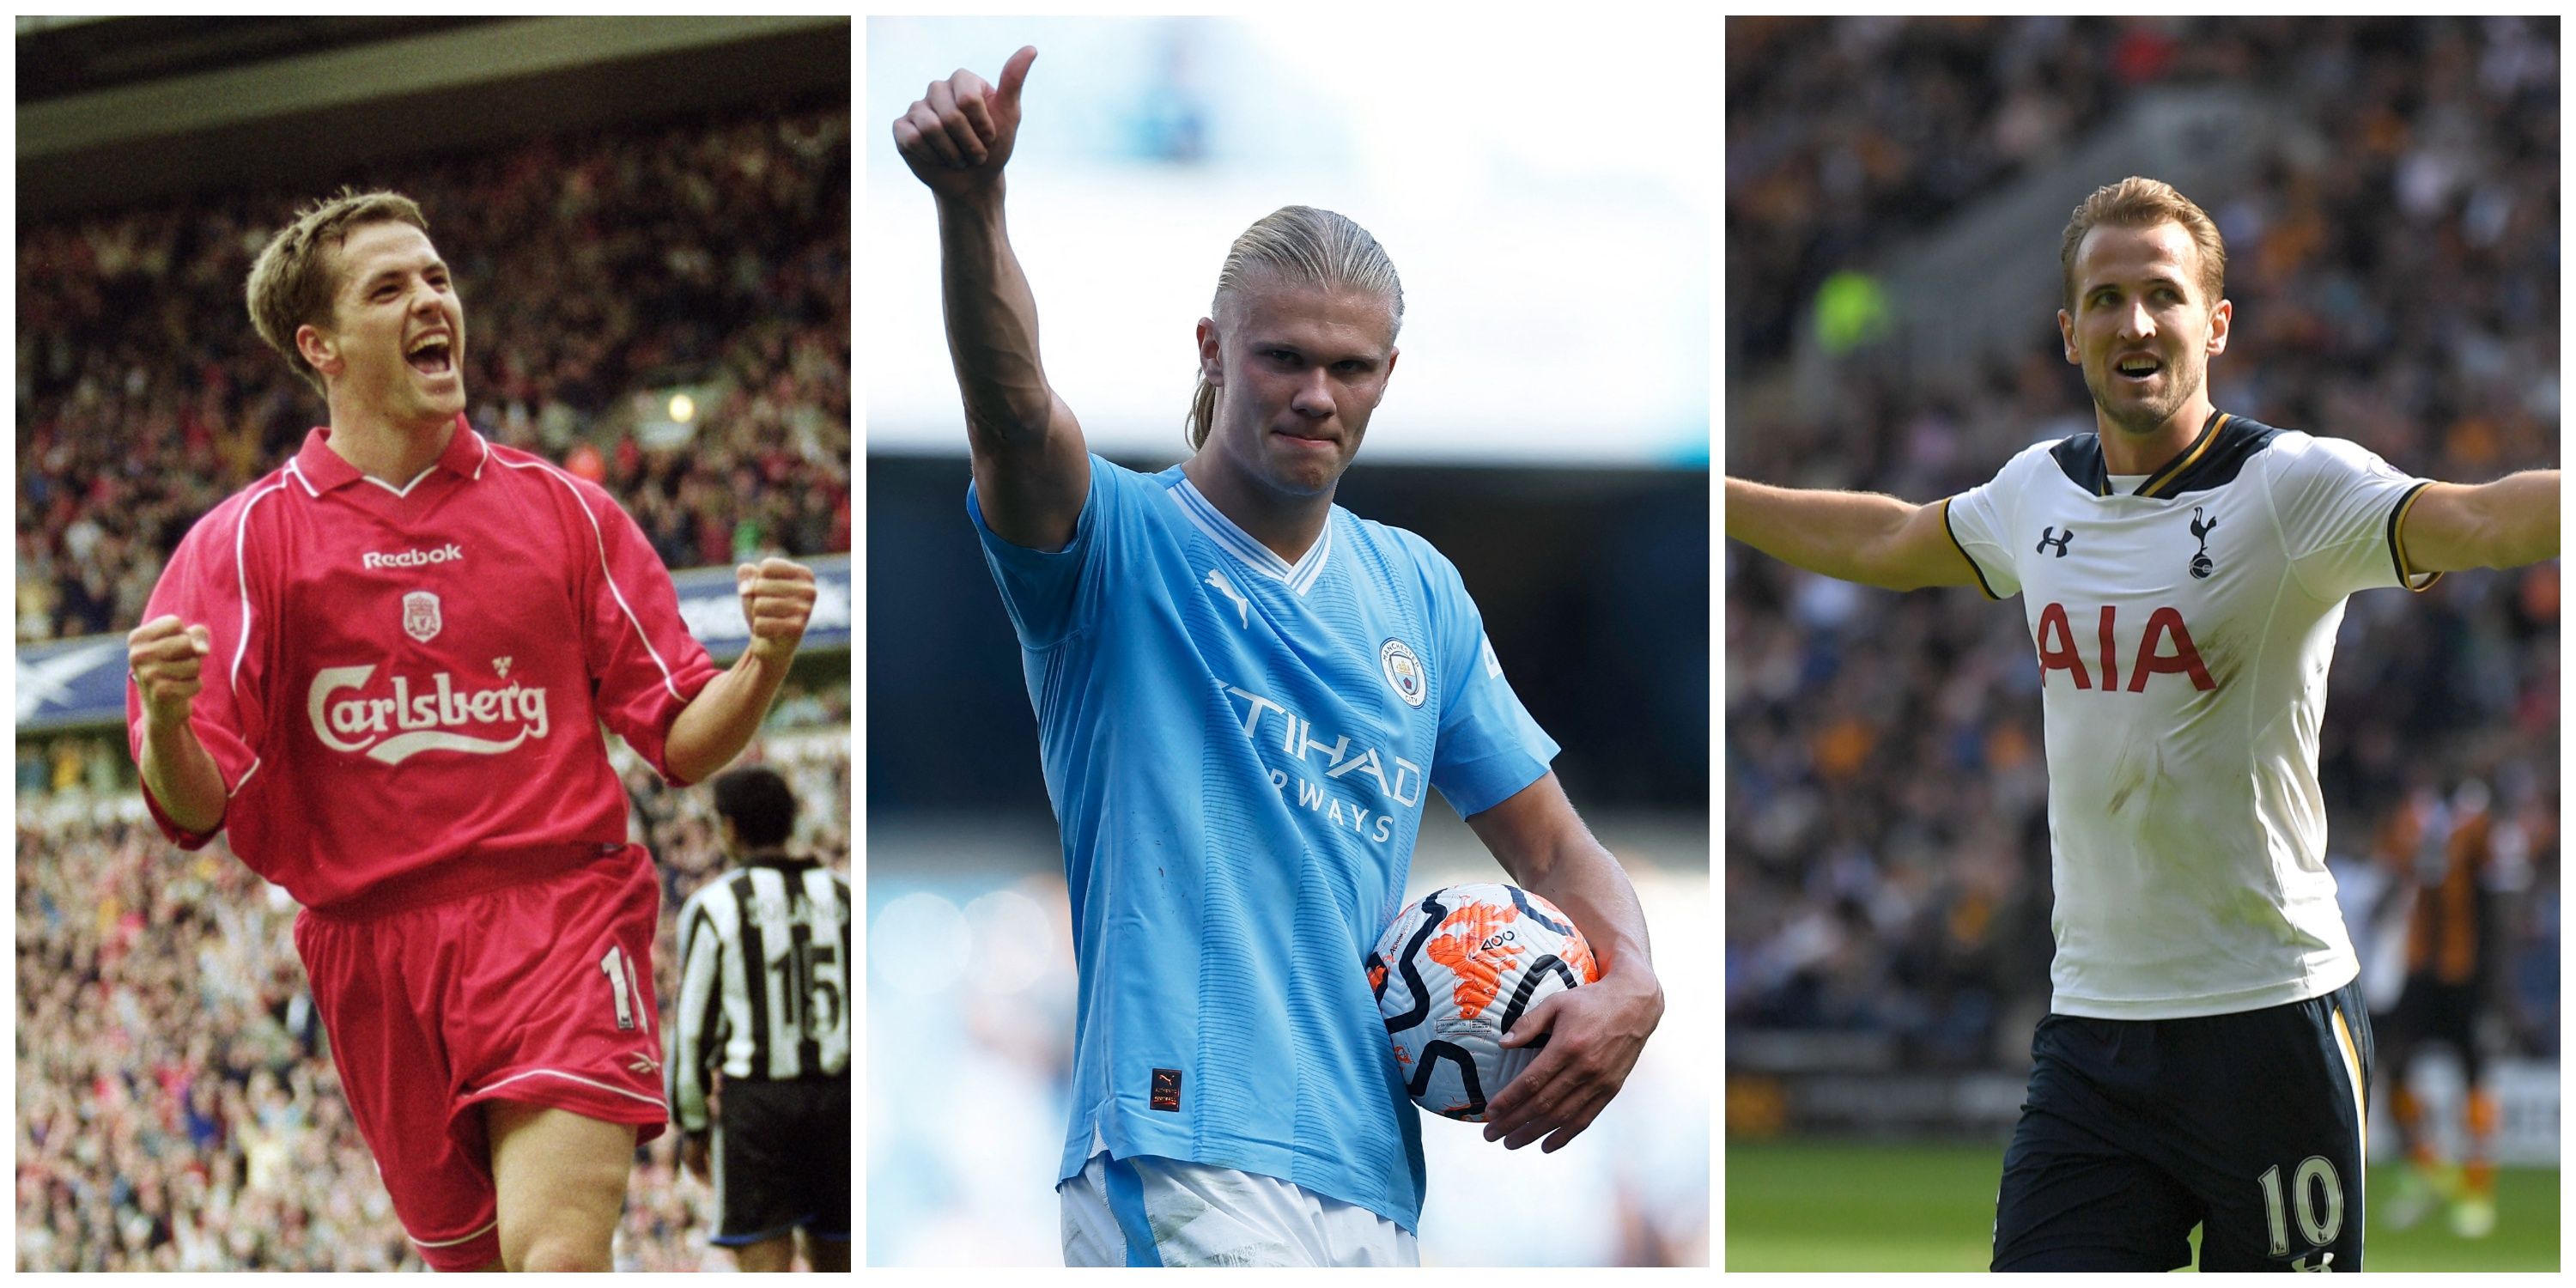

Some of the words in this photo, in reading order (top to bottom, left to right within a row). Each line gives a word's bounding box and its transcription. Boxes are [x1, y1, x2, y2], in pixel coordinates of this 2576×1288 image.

[362, 543, 463, 569] Reebok
[2038, 602, 2217, 693] AIA
[307, 664, 550, 754] Carlsberg
[1215, 677, 1421, 808] TIHAD
[1405, 695, 1418, 704] CITY
[1268, 768, 1394, 843] RWAYS
[767, 942, 841, 1037] 15
[2257, 1155, 2344, 1258] 10
